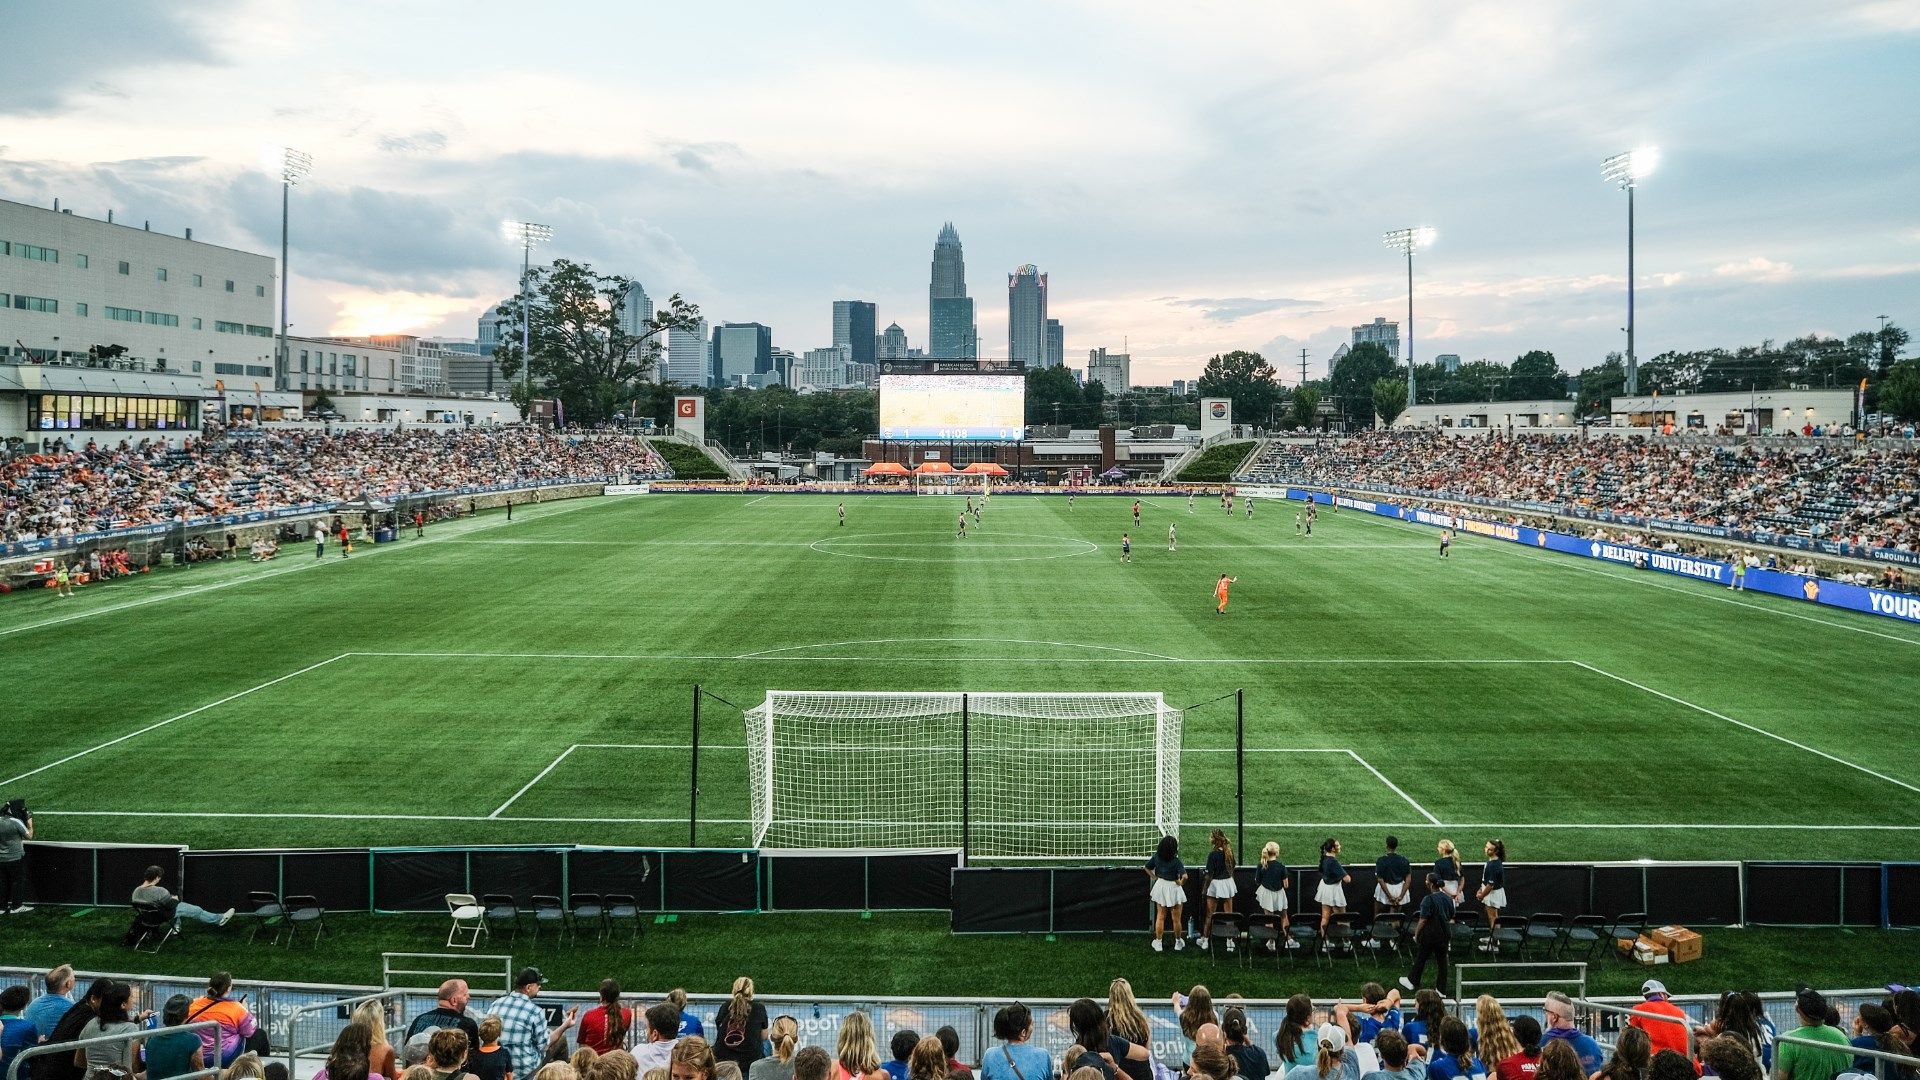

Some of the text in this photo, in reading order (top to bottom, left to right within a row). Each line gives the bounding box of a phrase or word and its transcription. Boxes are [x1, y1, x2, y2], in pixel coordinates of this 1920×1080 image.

[682, 403, 691, 414] G
[1000, 429, 1006, 438] 0
[1464, 519, 1495, 536] FINISHING
[1496, 525, 1519, 541] GOALS
[1874, 551, 1910, 564] CAROLINA
[1651, 553, 1722, 580] UNIVERSITY
[1869, 591, 1920, 619] YOUR
